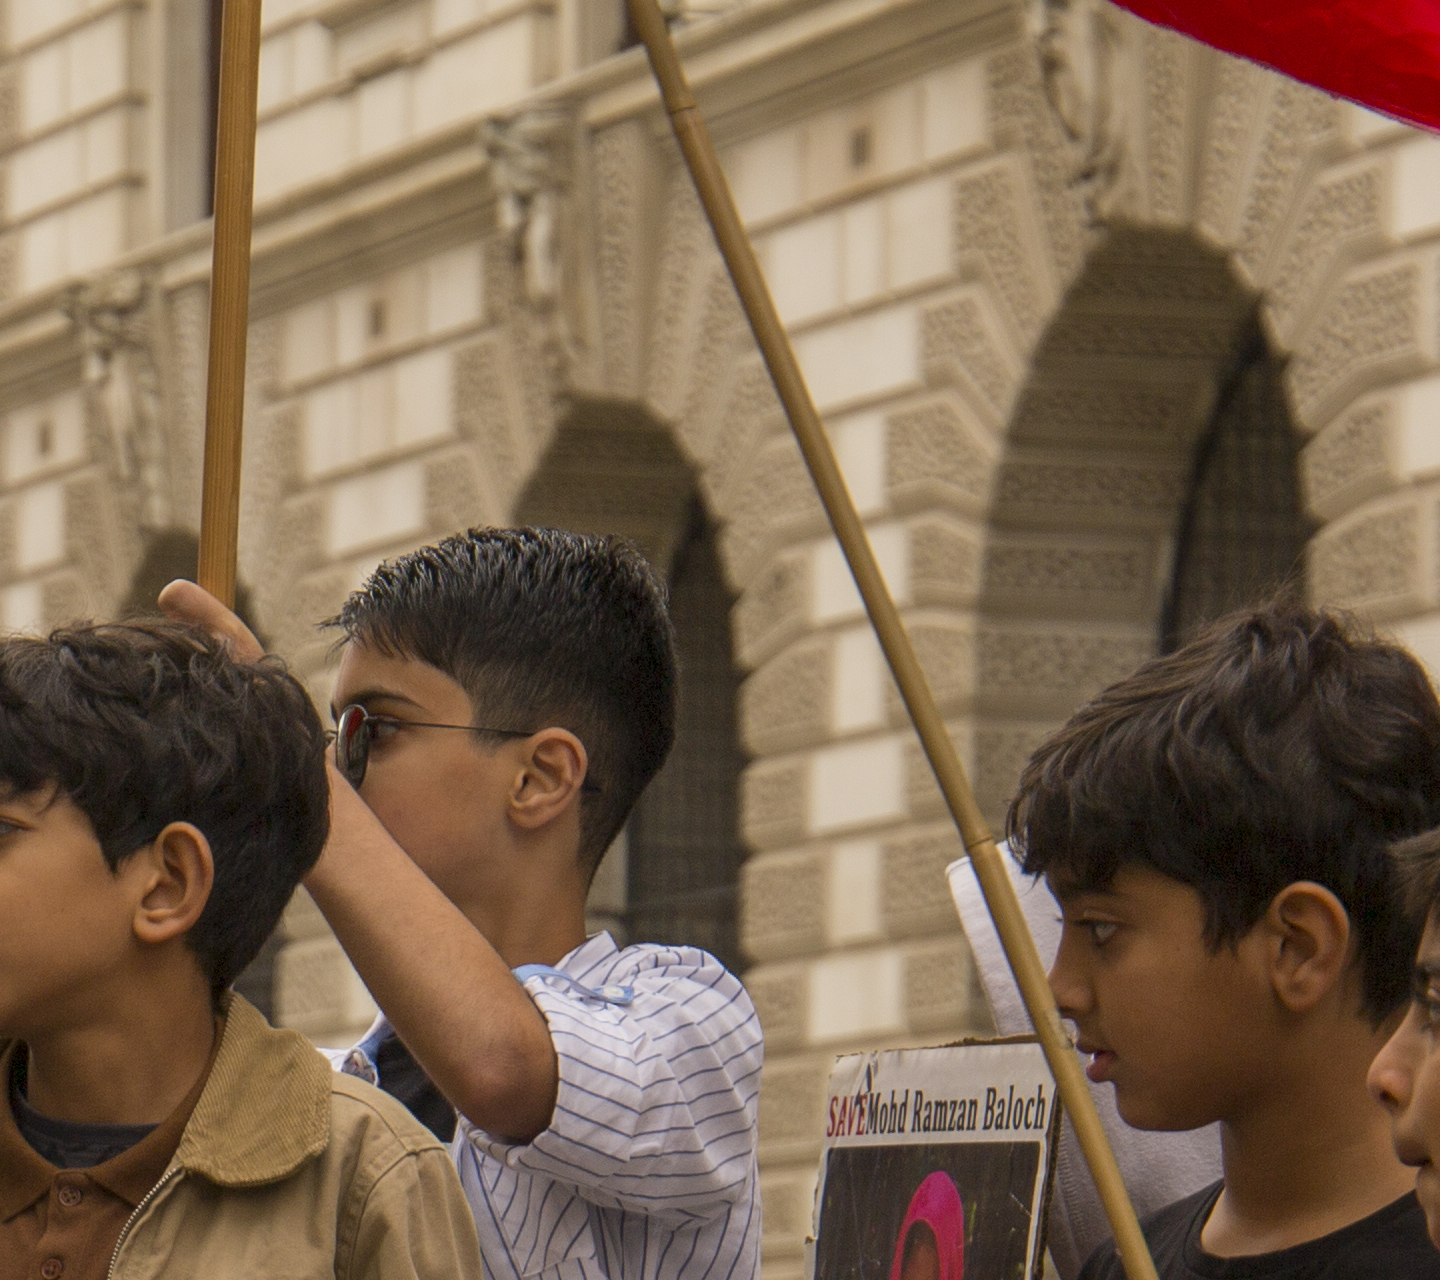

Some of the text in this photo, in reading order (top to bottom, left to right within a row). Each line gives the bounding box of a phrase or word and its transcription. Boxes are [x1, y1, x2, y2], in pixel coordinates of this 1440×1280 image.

[826, 1084, 1046, 1137] SAVE Mohd Ramzan Baloch
